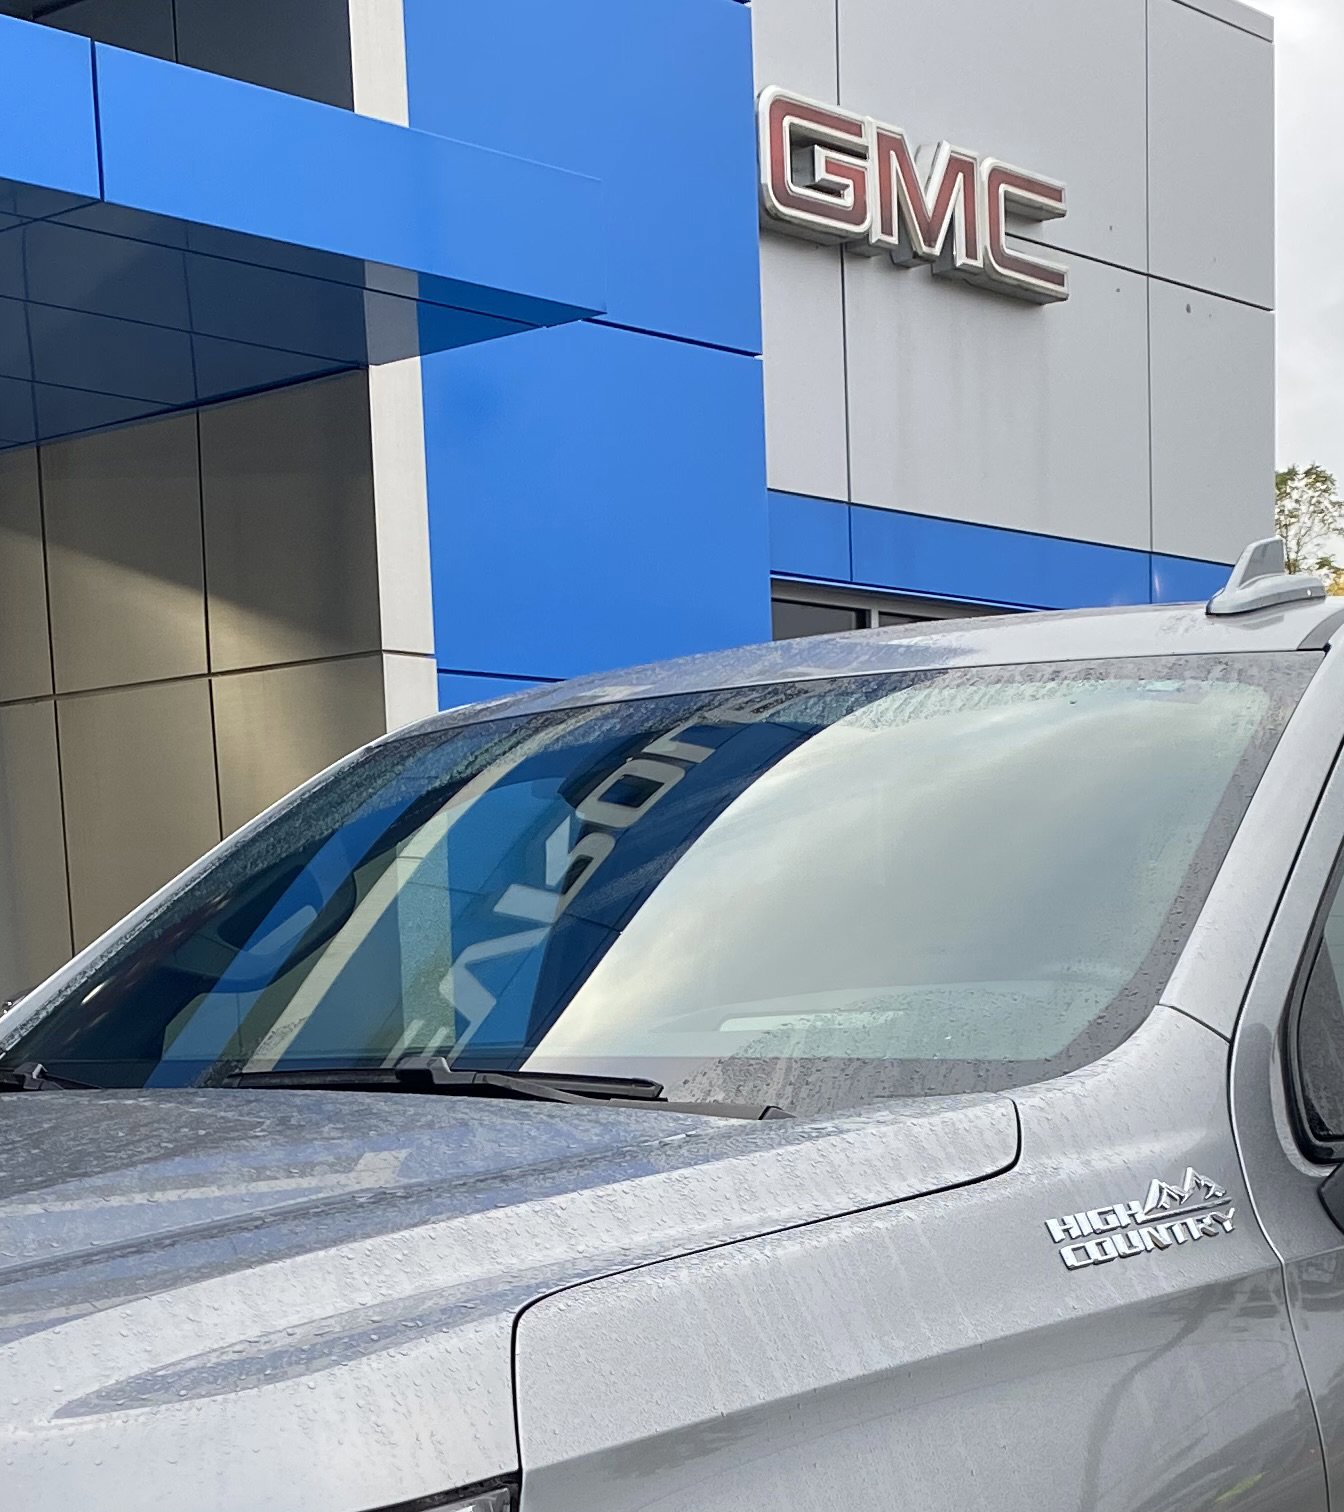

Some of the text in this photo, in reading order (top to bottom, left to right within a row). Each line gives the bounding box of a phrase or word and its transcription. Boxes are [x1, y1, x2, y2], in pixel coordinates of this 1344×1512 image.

[757, 84, 1069, 305] GMC
[1045, 1200, 1146, 1243] HIGH
[1059, 1207, 1236, 1270] COUNTRY
